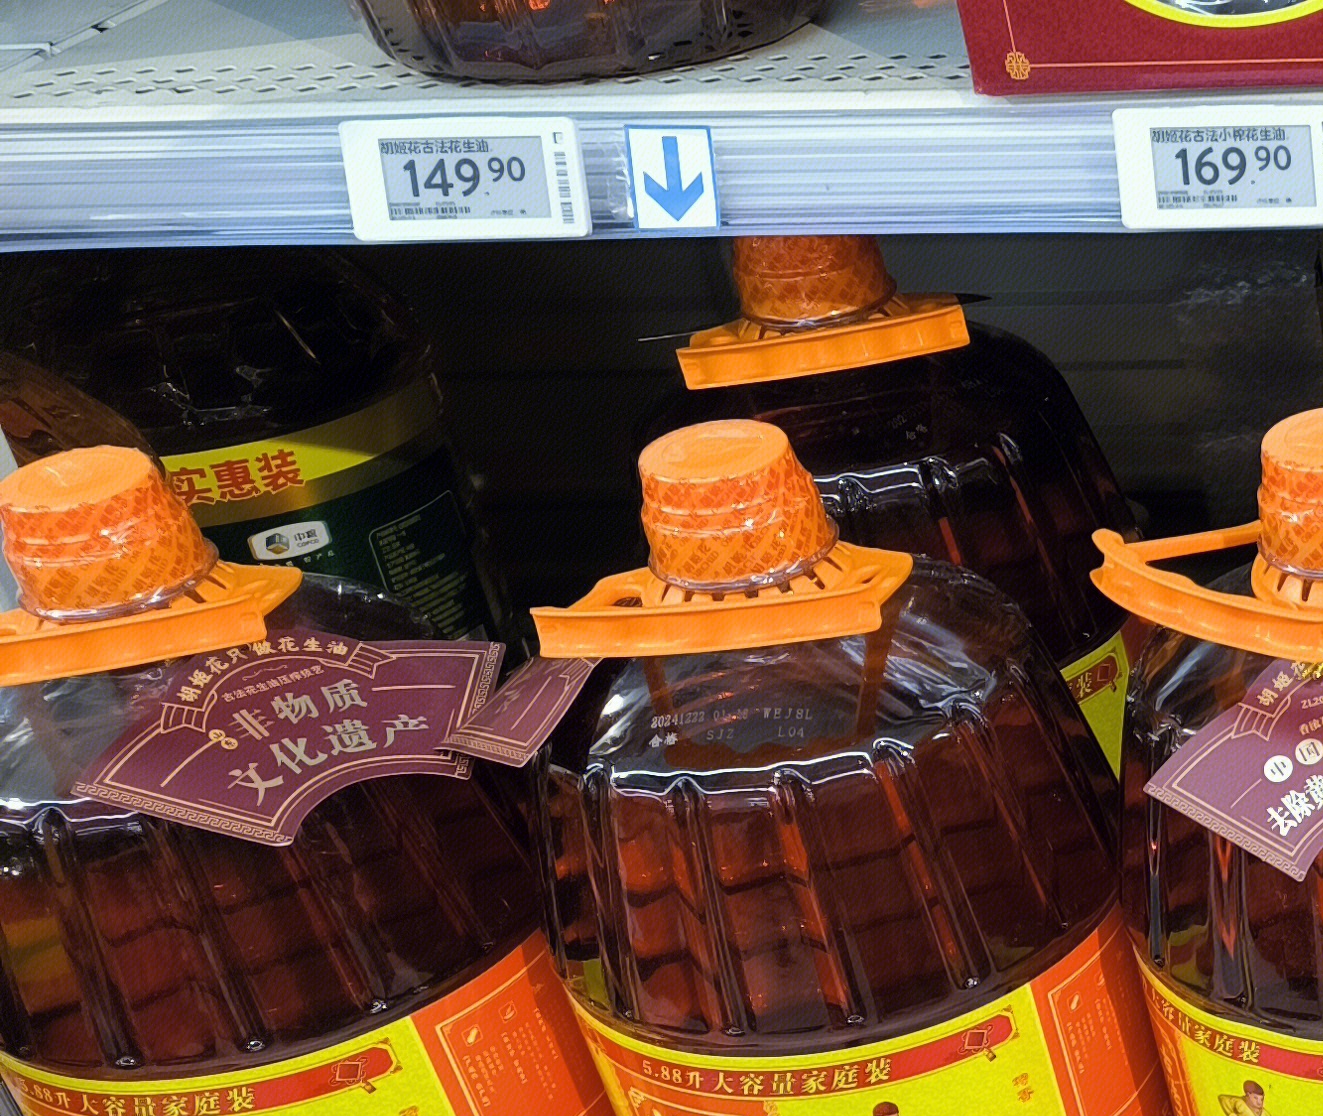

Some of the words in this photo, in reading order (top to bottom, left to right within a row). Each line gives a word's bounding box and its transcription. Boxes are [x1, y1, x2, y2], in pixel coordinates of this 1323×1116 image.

[170, 448, 307, 505] 实惠装
[178, 634, 350, 705] 胡姬花只做花生油
[230, 678, 369, 742] 非物质
[648, 731, 679, 749] 合格
[226, 713, 431, 807] 文化遗产
